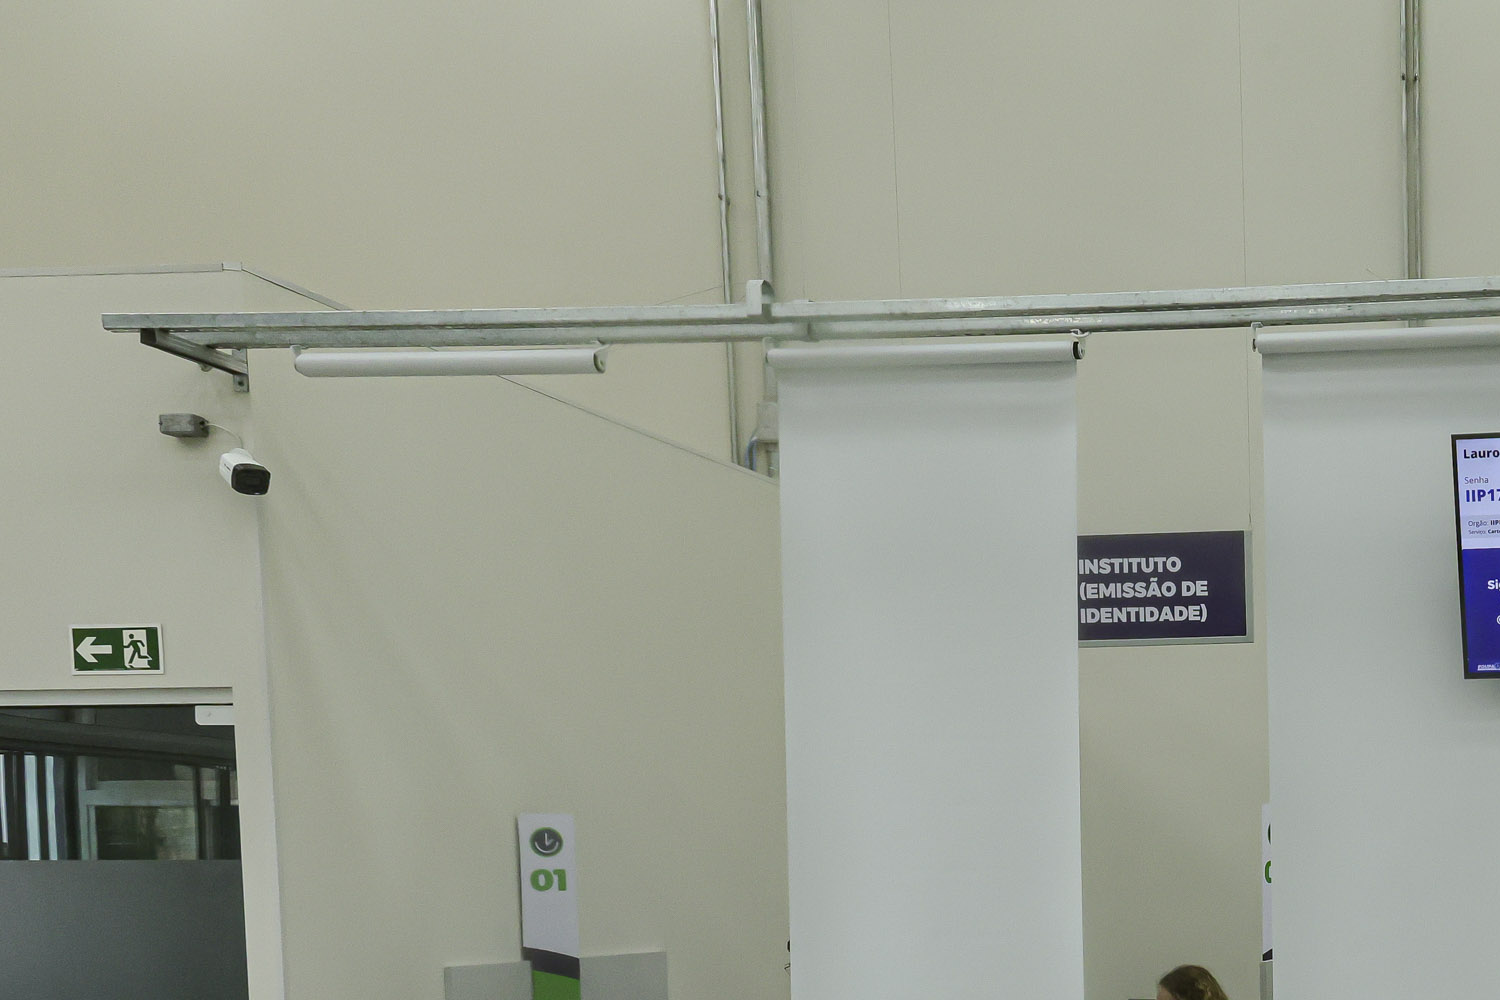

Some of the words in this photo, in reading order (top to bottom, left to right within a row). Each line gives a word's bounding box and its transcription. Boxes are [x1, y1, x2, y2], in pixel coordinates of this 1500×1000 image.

[1463, 447, 1500, 459] Lauro
[1464, 476, 1489, 485] Senha
[1079, 556, 1182, 575] INSTITUTO
[1079, 577, 1177, 600] (EMISSÃO
[1181, 580, 1209, 597] DE
[1080, 603, 1208, 623] IDENTIDADE)
[530, 868, 567, 892] 01
